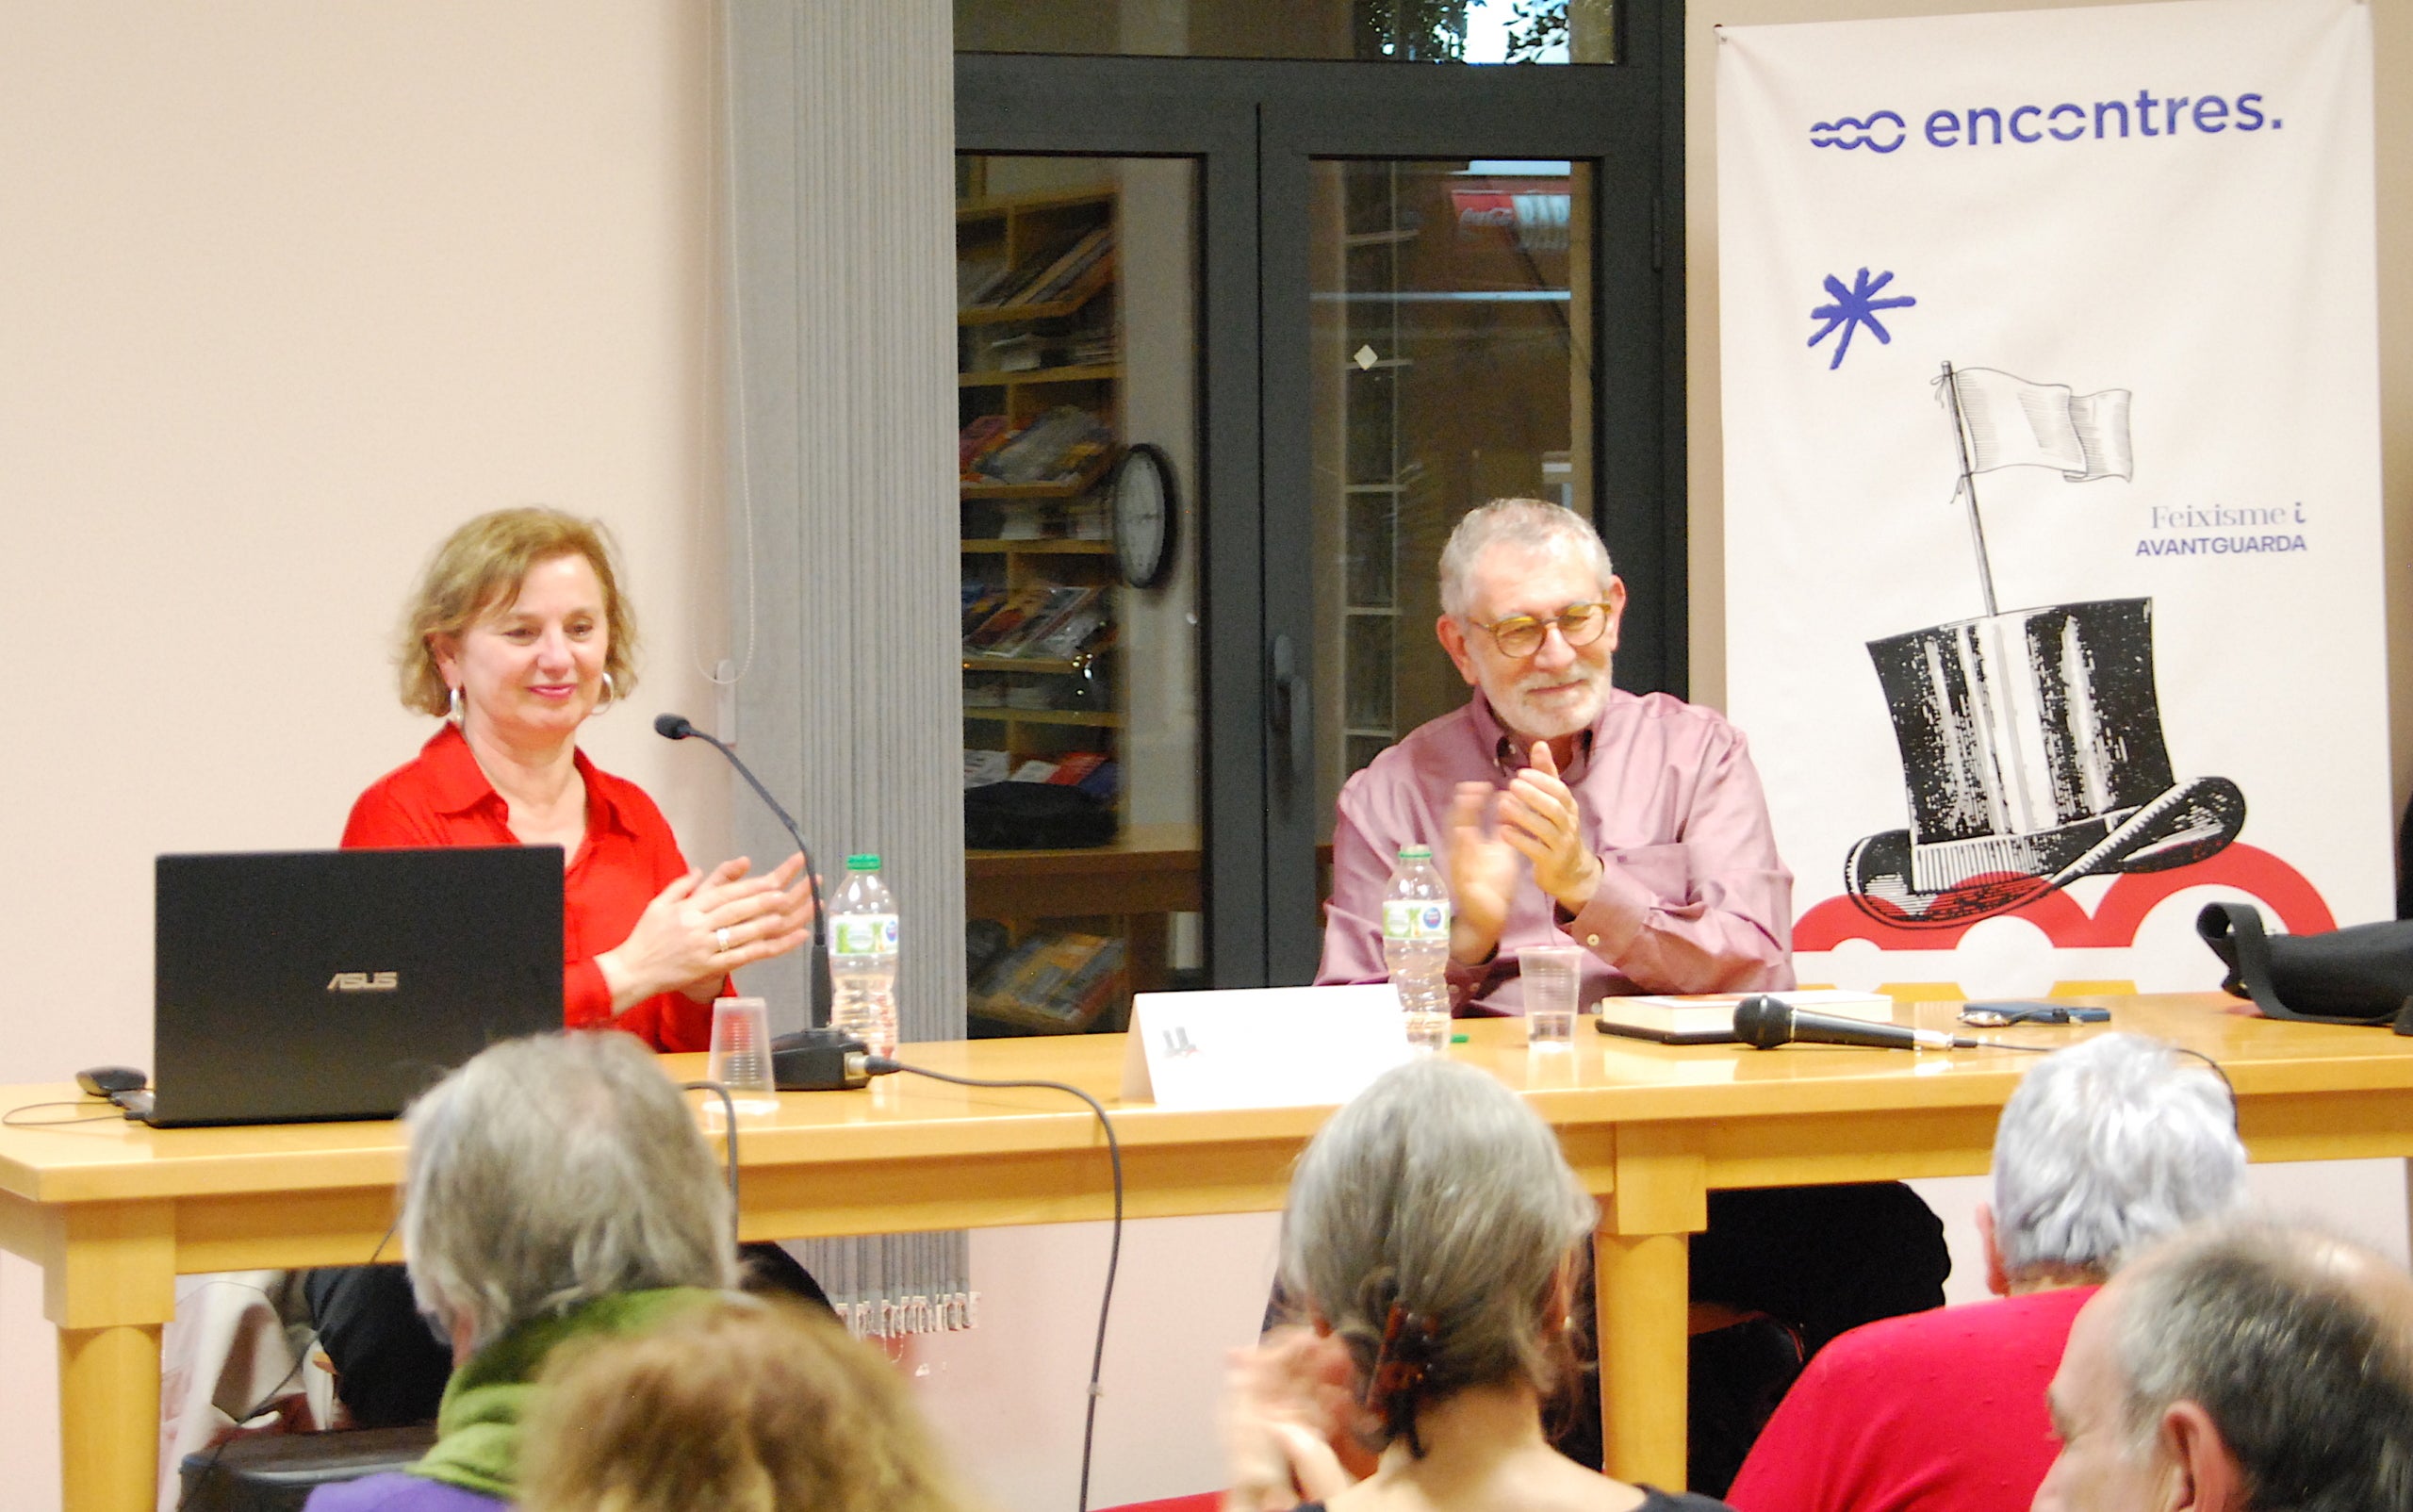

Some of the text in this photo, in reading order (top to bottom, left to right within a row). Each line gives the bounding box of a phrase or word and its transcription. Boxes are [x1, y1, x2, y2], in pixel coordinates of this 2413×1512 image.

[1924, 89, 2284, 148] encontres.
[2151, 501, 2306, 529] Feixisme i
[2135, 534, 2307, 557] AVANTGUARDA
[326, 971, 398, 991] ASUS
